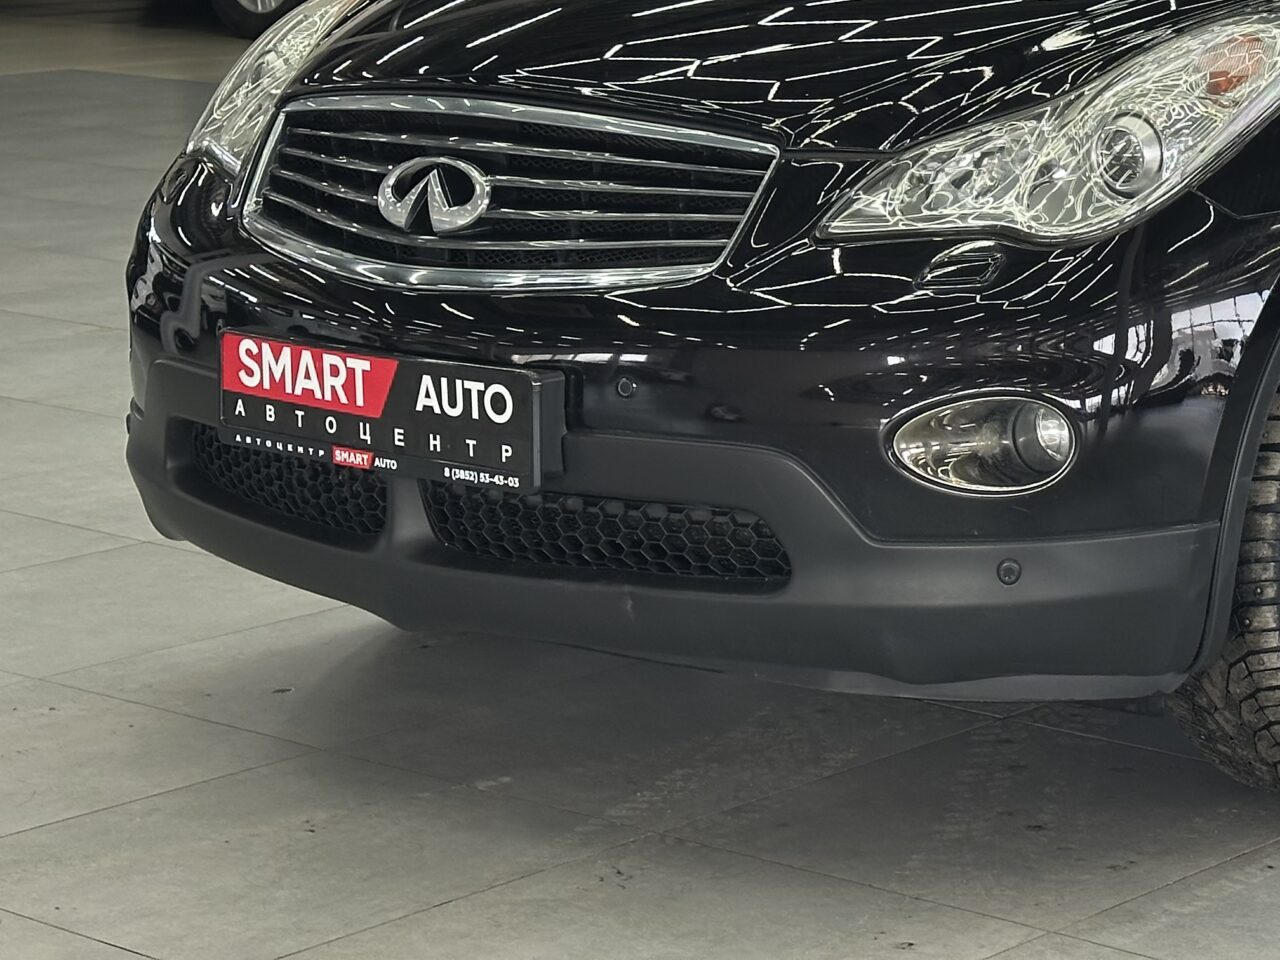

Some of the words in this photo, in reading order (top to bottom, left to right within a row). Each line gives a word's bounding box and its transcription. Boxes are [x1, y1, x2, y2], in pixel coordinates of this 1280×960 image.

[238, 338, 371, 407] SMART
[415, 374, 514, 424] AUTO
[234, 398, 513, 463] АВТОЦЕНТР
[235, 434, 325, 457] АВТОЦЕНТР
[334, 449, 369, 466] SMART
[373, 457, 398, 470] AUTO
[443, 466, 451, 478] 8
[451, 468, 479, 484] (3852)
[479, 472, 520, 488] 53-43-03
